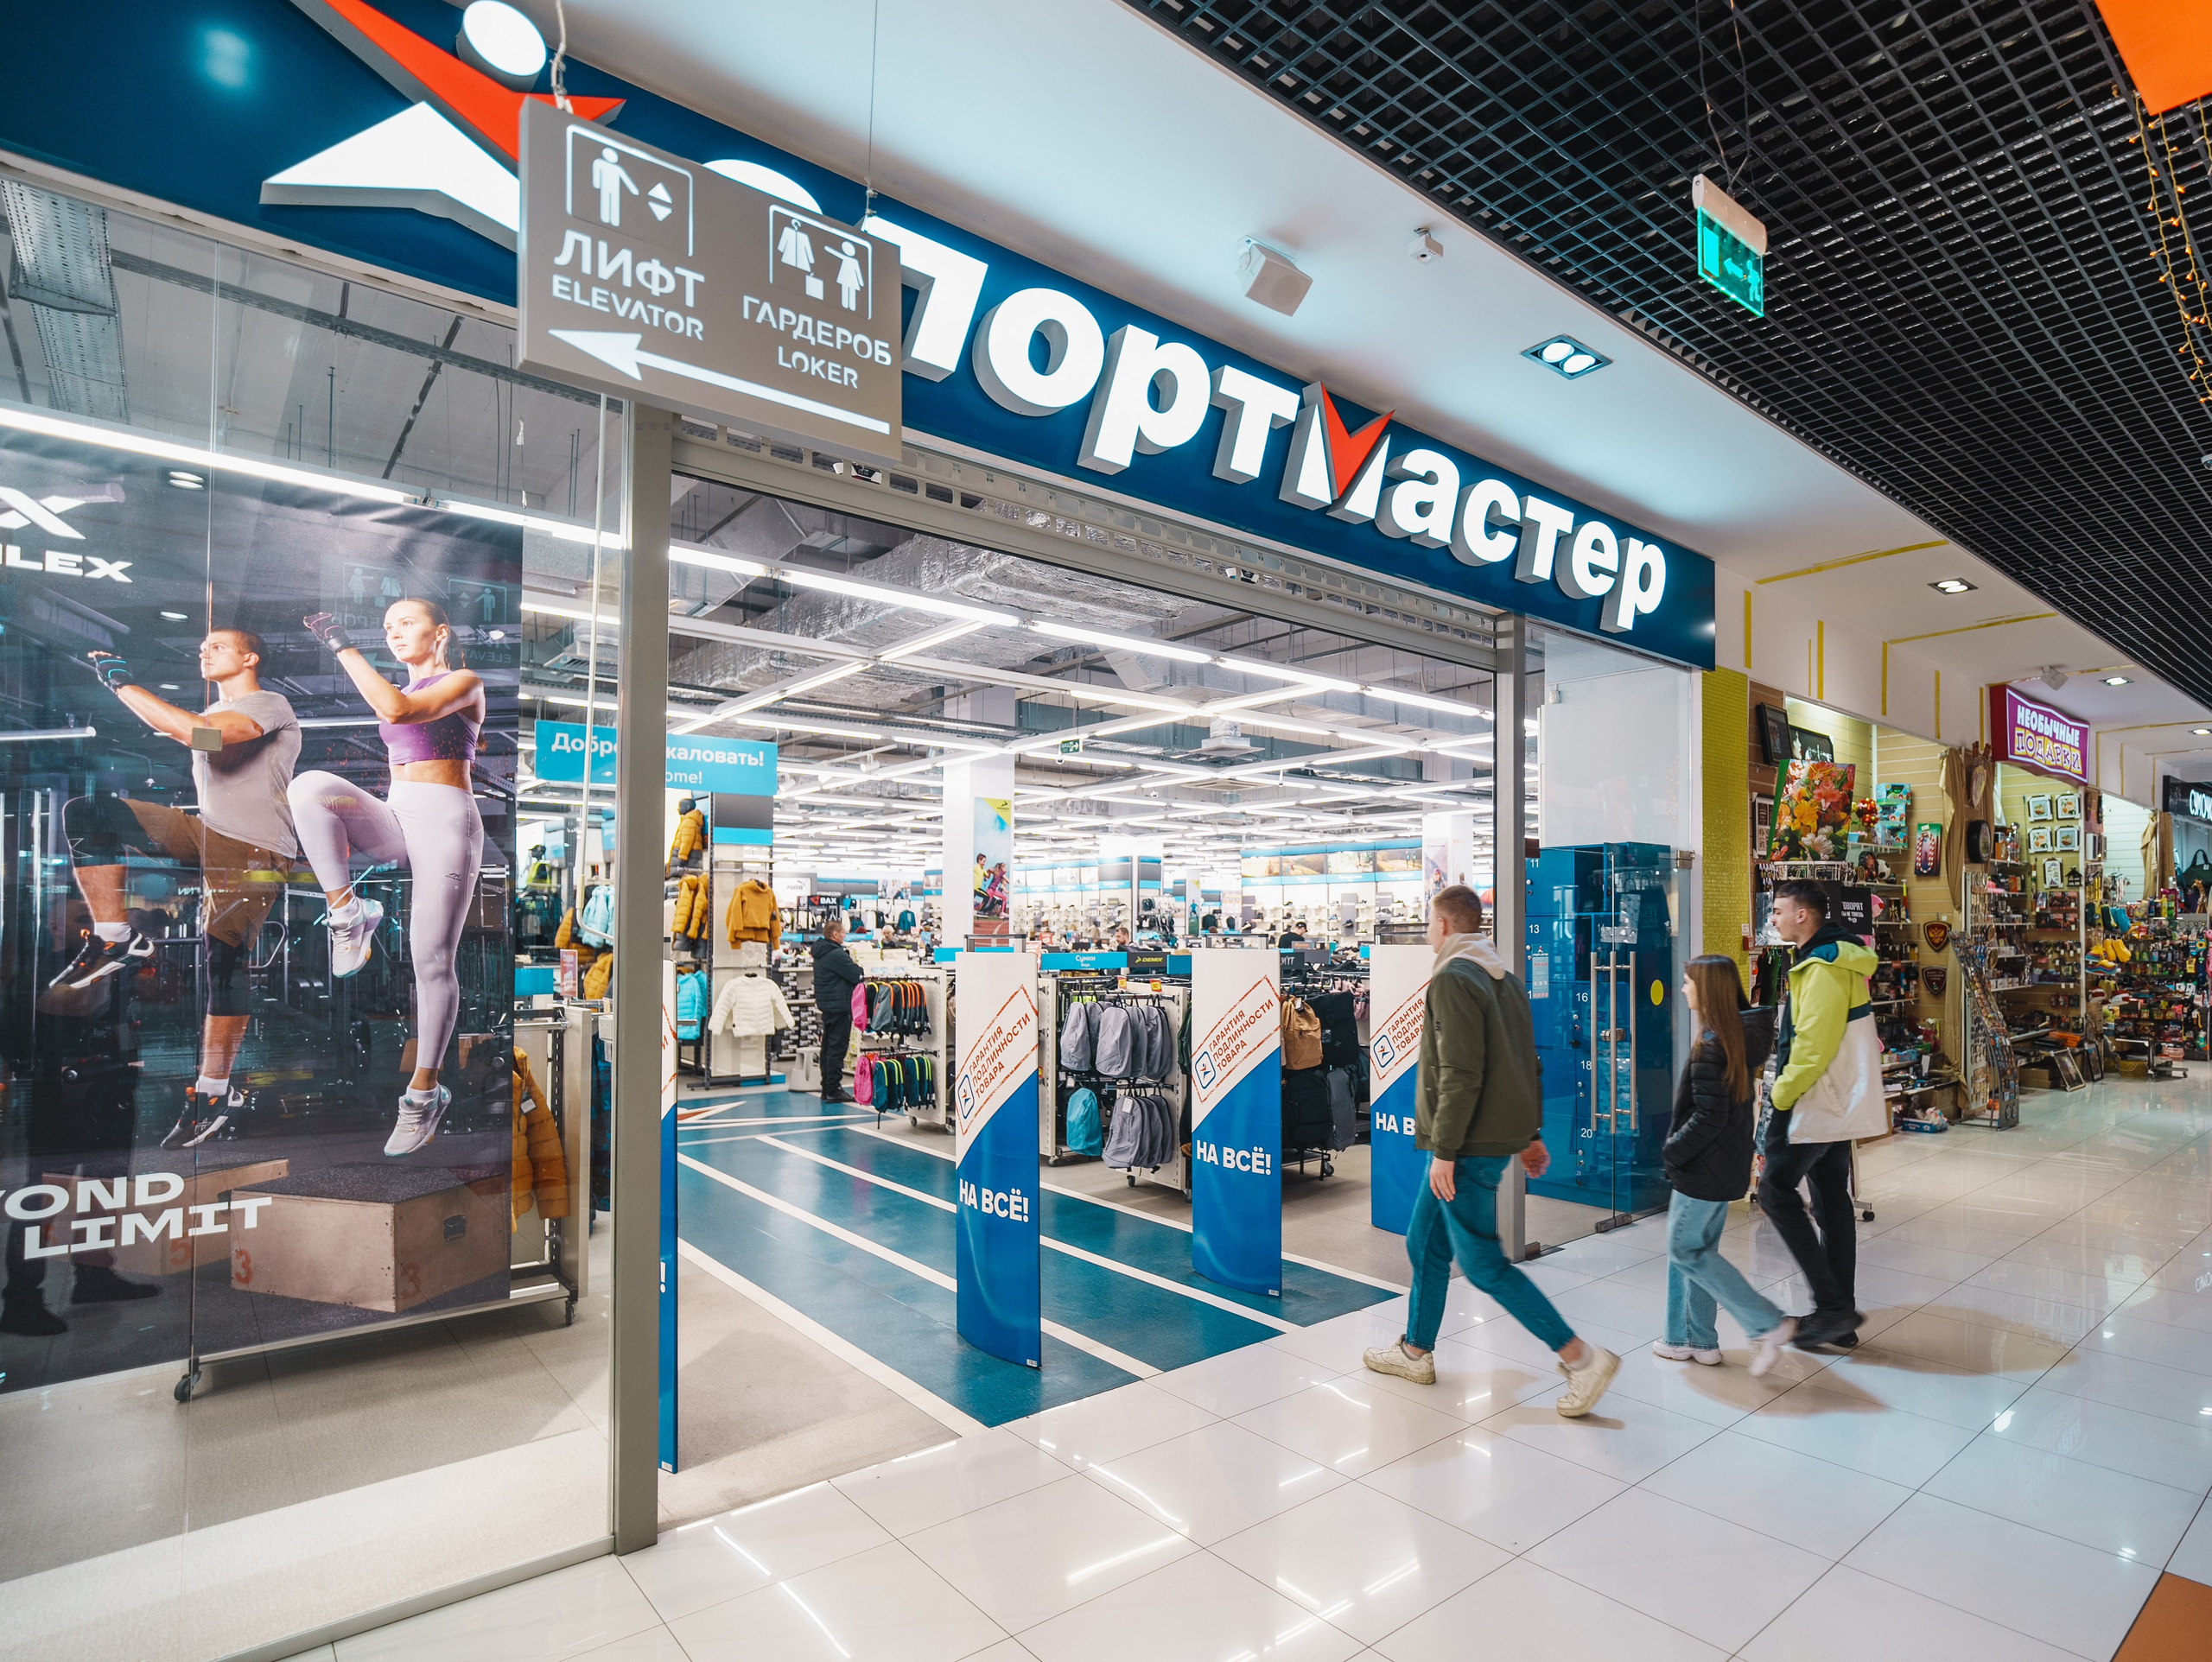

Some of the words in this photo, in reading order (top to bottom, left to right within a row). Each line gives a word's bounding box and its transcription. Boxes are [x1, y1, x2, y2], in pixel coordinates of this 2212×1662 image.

[553, 228, 705, 308] ЛИФТ
[551, 274, 704, 341] ELEVATOR
[742, 295, 893, 367] ГАРДЕРОБ
[777, 345, 858, 390] LOKER
[0, 543, 134, 583] LEX
[550, 732, 616, 755] Добр
[2017, 704, 2081, 748] НЕОБЫЧНЫЕ
[2015, 727, 2082, 774] ПОДАРКИ
[1530, 859, 1540, 868] 11
[1529, 923, 1541, 934] 13
[1075, 955, 1096, 963] Сумки
[1387, 998, 1425, 1036] ГАРАНТИЯ
[1576, 992, 1589, 1002] 16
[969, 1024, 1004, 1076] ГАРАНТИЯ
[971, 1012, 1031, 1088] ПОДЛИННОСТИ
[1209, 1009, 1247, 1052] ГАРАНТИЯ
[1212, 999, 1274, 1063] ПОДЛИННОСТИ
[1216, 1039, 1248, 1073] ТОВАРА
[1580, 1060, 1592, 1070] 18
[975, 1060, 1005, 1100] ТОВАРА
[1375, 1111, 1400, 1134] НА
[1580, 1127, 1593, 1139] 20
[1196, 1139, 1219, 1166] НА
[1223, 1145, 1273, 1177] ВСЁ!
[0, 1171, 185, 1221] OND
[959, 1177, 978, 1210] НА
[981, 1187, 1030, 1224] ВСЁ!
[23, 1196, 272, 1260] LIMIT
[234, 1248, 254, 1285] 3
